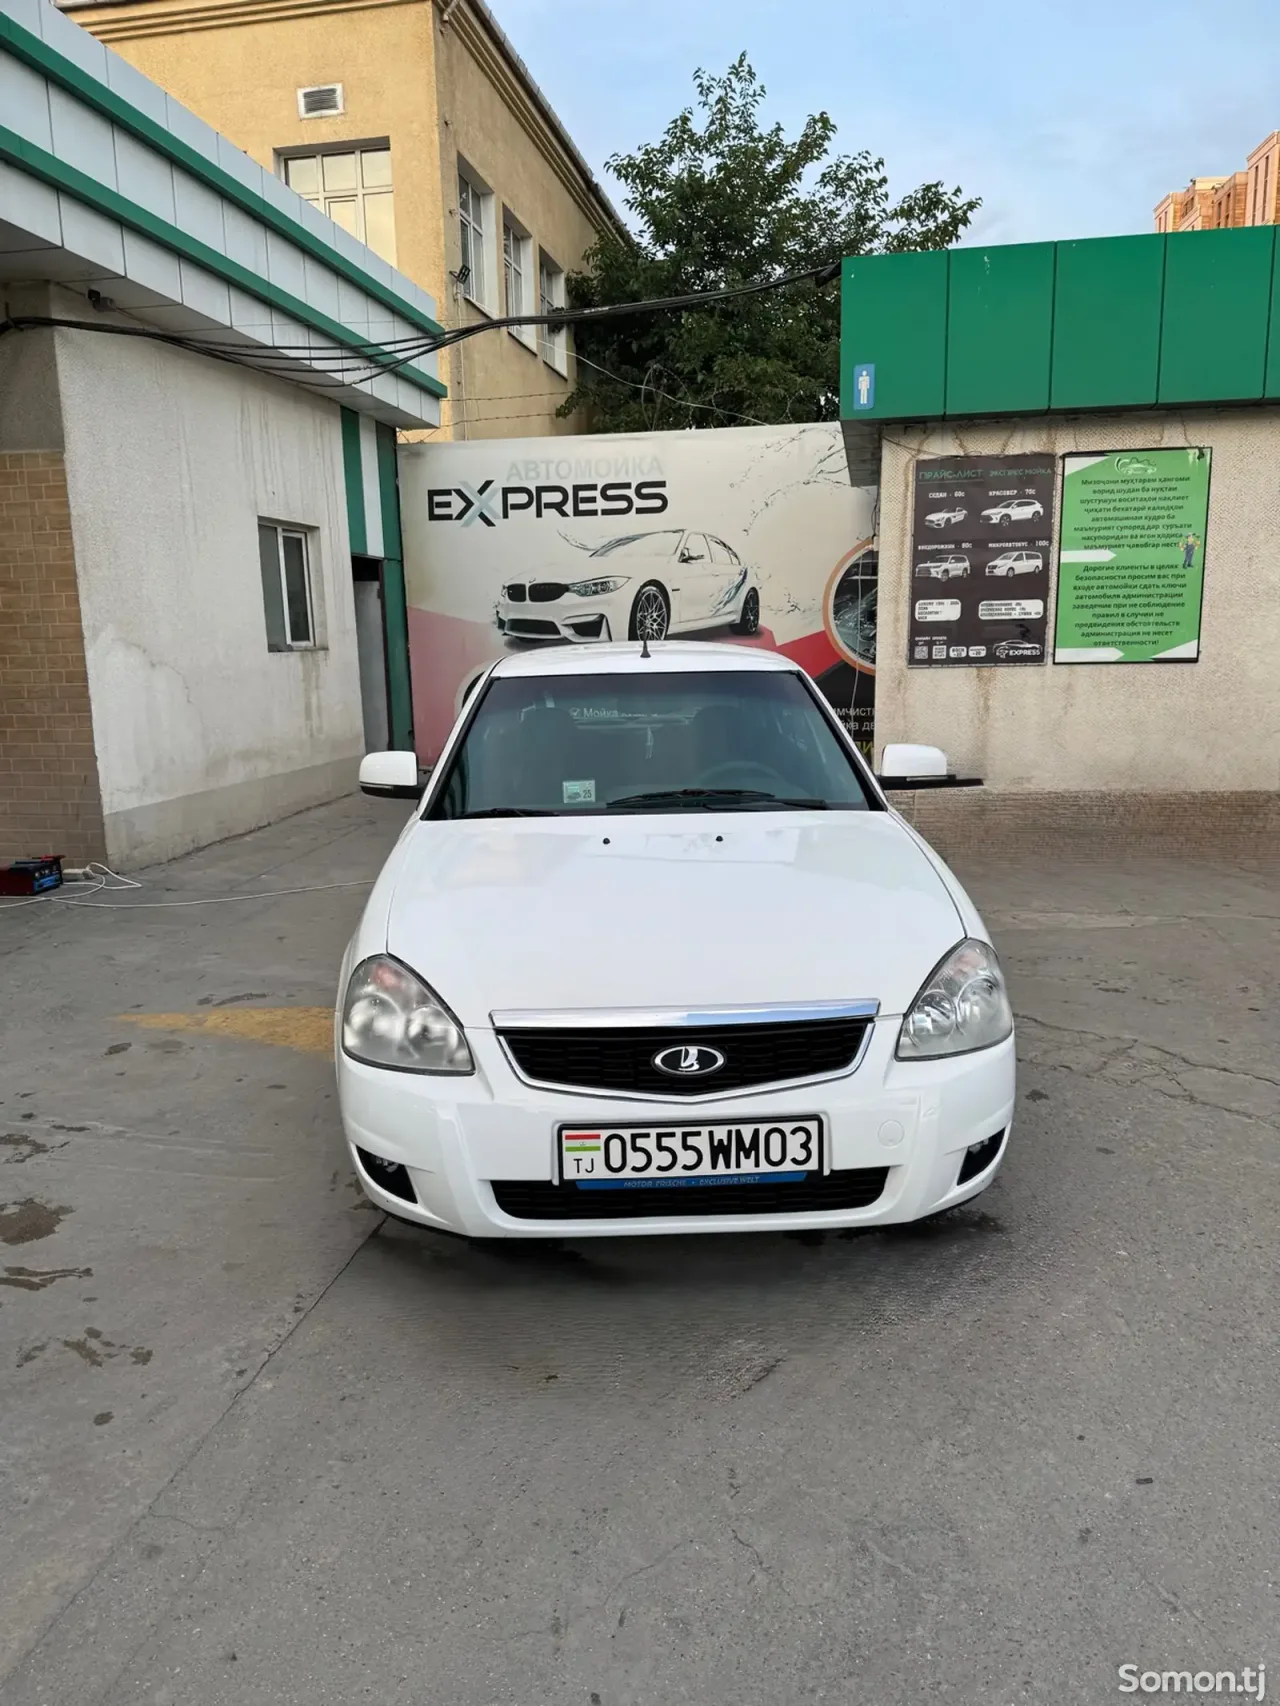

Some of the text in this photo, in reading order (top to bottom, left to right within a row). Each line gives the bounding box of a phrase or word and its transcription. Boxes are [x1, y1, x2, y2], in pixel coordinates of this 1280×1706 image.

[505, 453, 664, 482] АВТОМОЙКА
[1024, 467, 1052, 476] МОЙКА
[919, 469, 984, 480] ПРАЙС-ЛИСТ
[427, 479, 669, 528] EXPRESS
[1083, 565, 1115, 573] Дорогие
[1121, 592, 1184, 600] администрации
[582, 789, 592, 799] 25
[604, 1126, 812, 1174] 0555WM03
[573, 1158, 594, 1174] TJ
